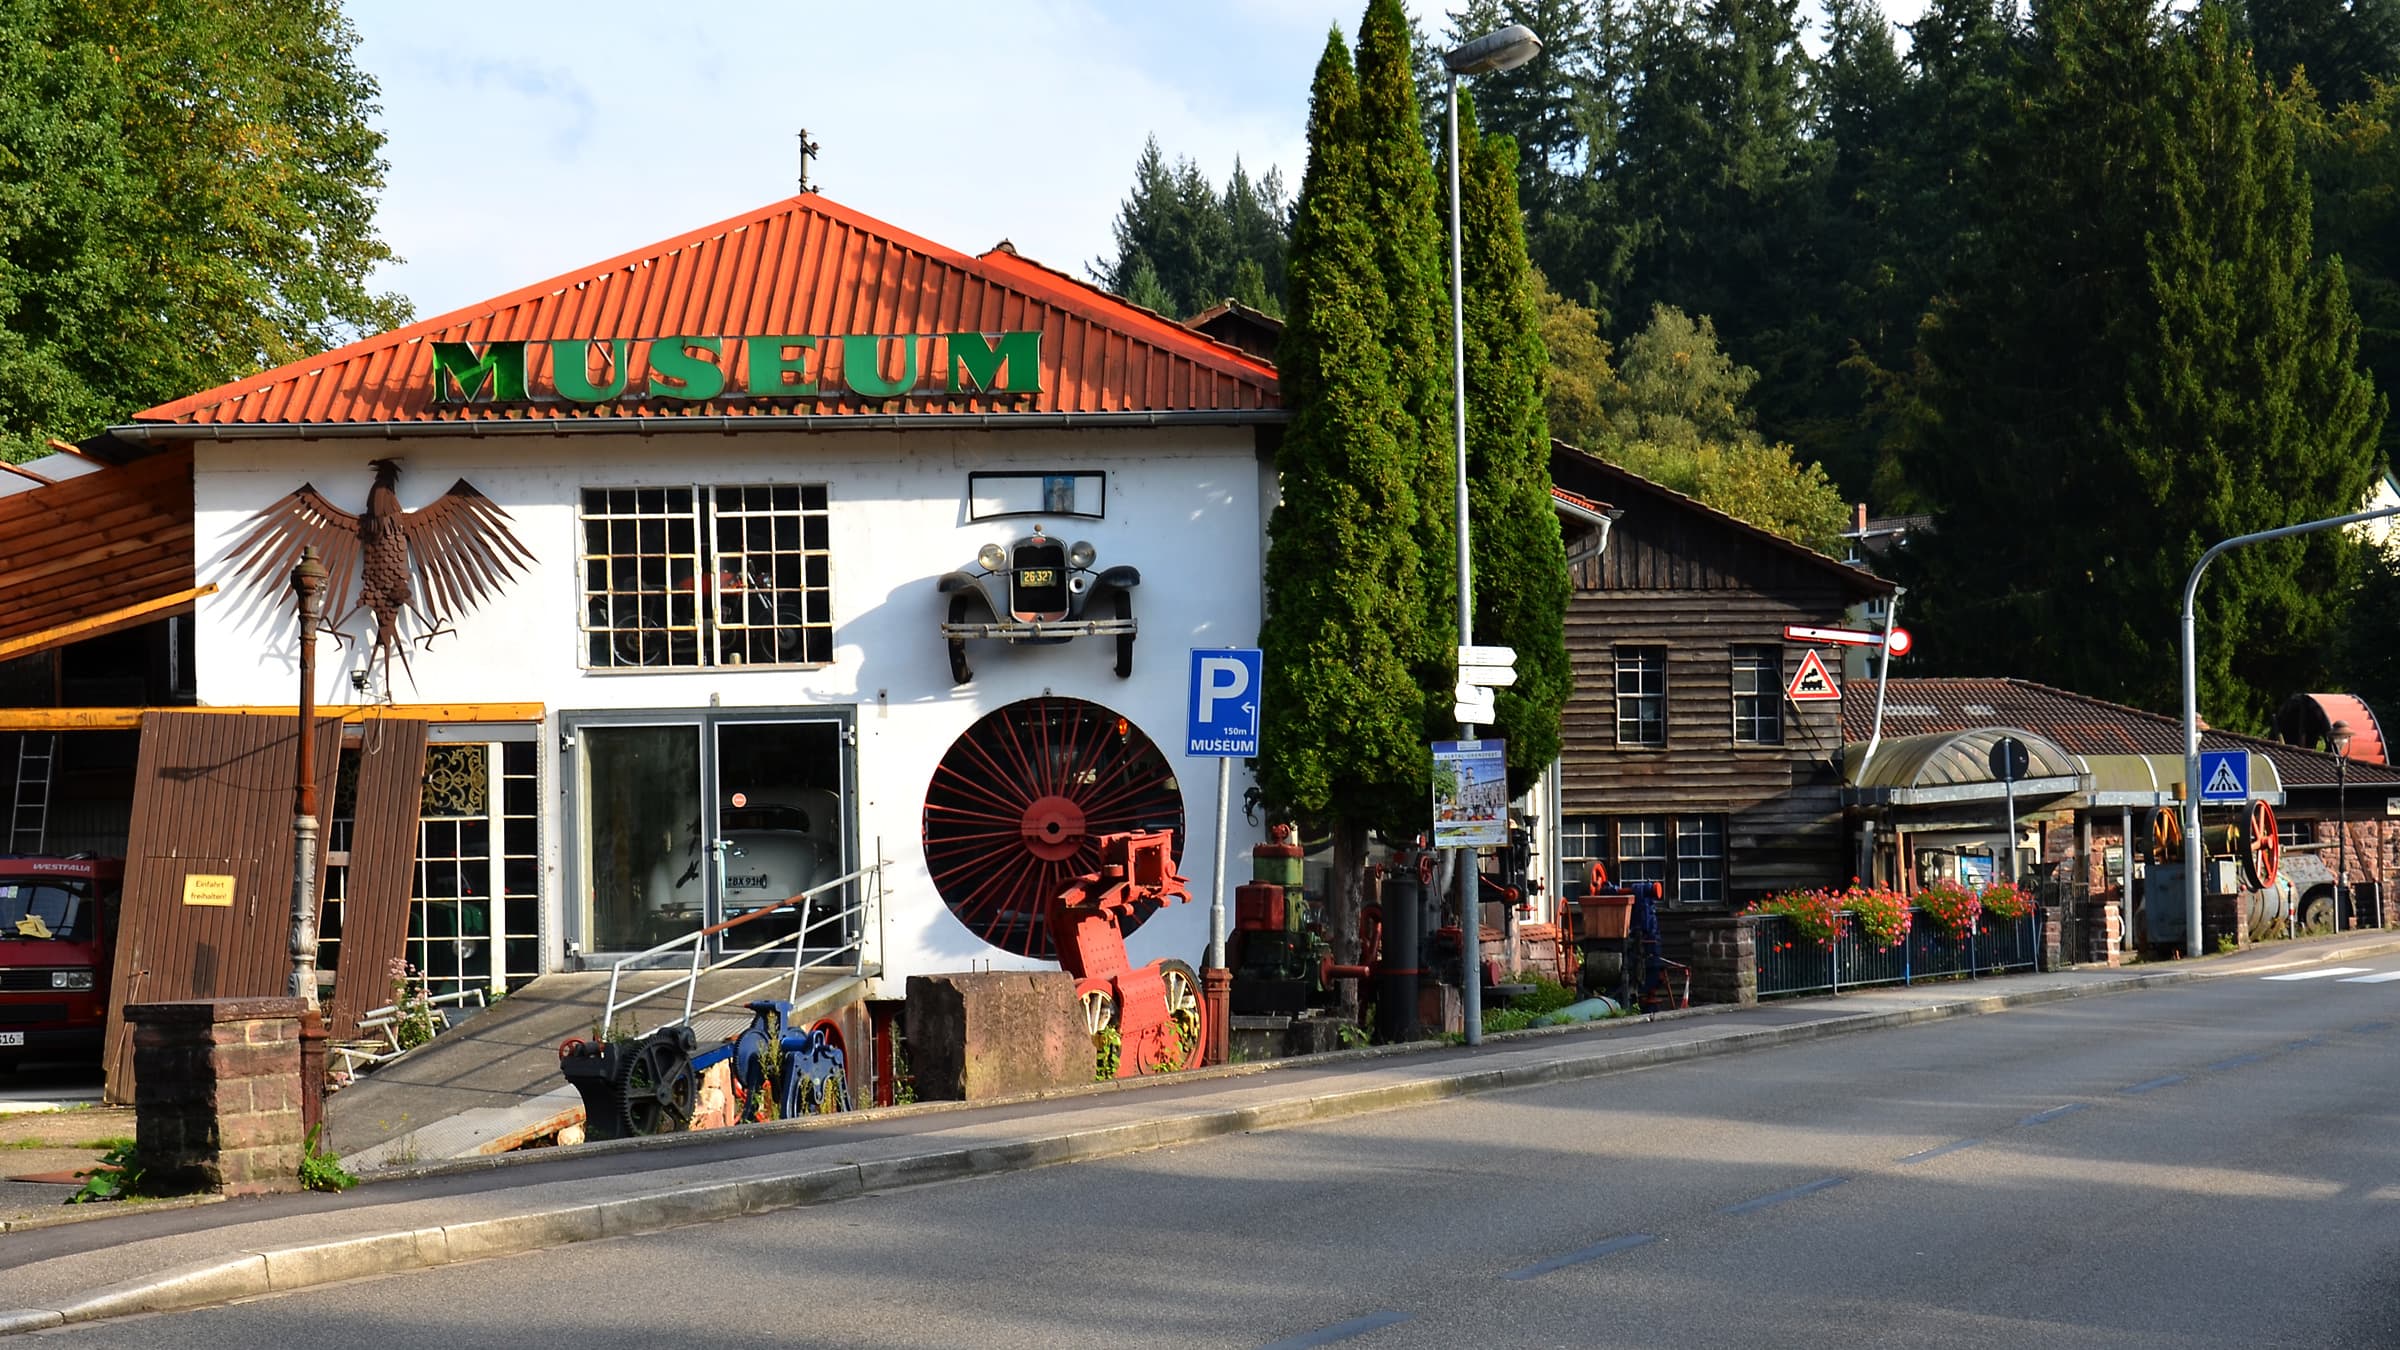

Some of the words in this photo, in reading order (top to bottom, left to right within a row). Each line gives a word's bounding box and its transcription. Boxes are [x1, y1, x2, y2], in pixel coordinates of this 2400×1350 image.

[430, 330, 1044, 402] MUSEUM
[1198, 657, 1249, 723] P
[1223, 727, 1247, 736] 150m
[1191, 739, 1254, 752] MUSEUM
[33, 863, 91, 872] WESTFALIA
[195, 880, 224, 888] Einfahrt
